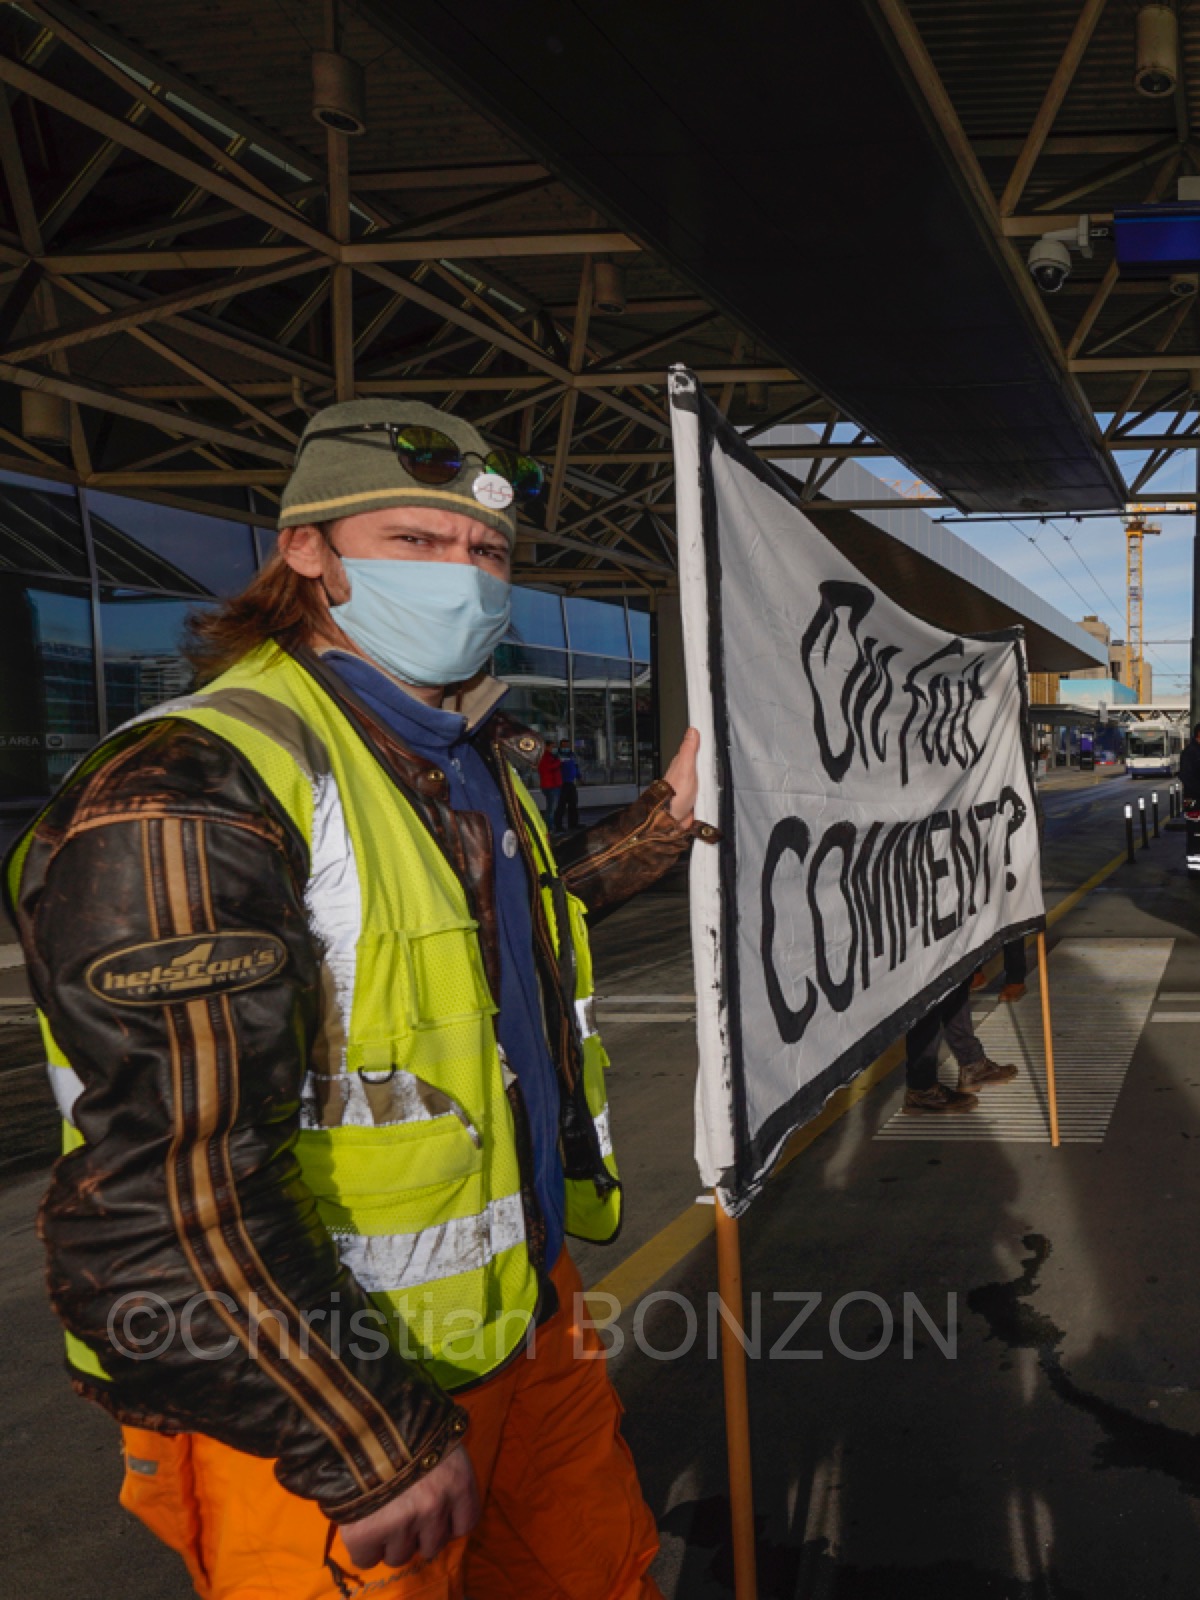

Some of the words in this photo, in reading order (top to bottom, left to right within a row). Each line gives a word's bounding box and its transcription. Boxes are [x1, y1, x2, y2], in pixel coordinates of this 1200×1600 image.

[8, 735, 40, 746] AREA
[801, 579, 902, 783] On
[760, 785, 1026, 1044] COMMENT?
